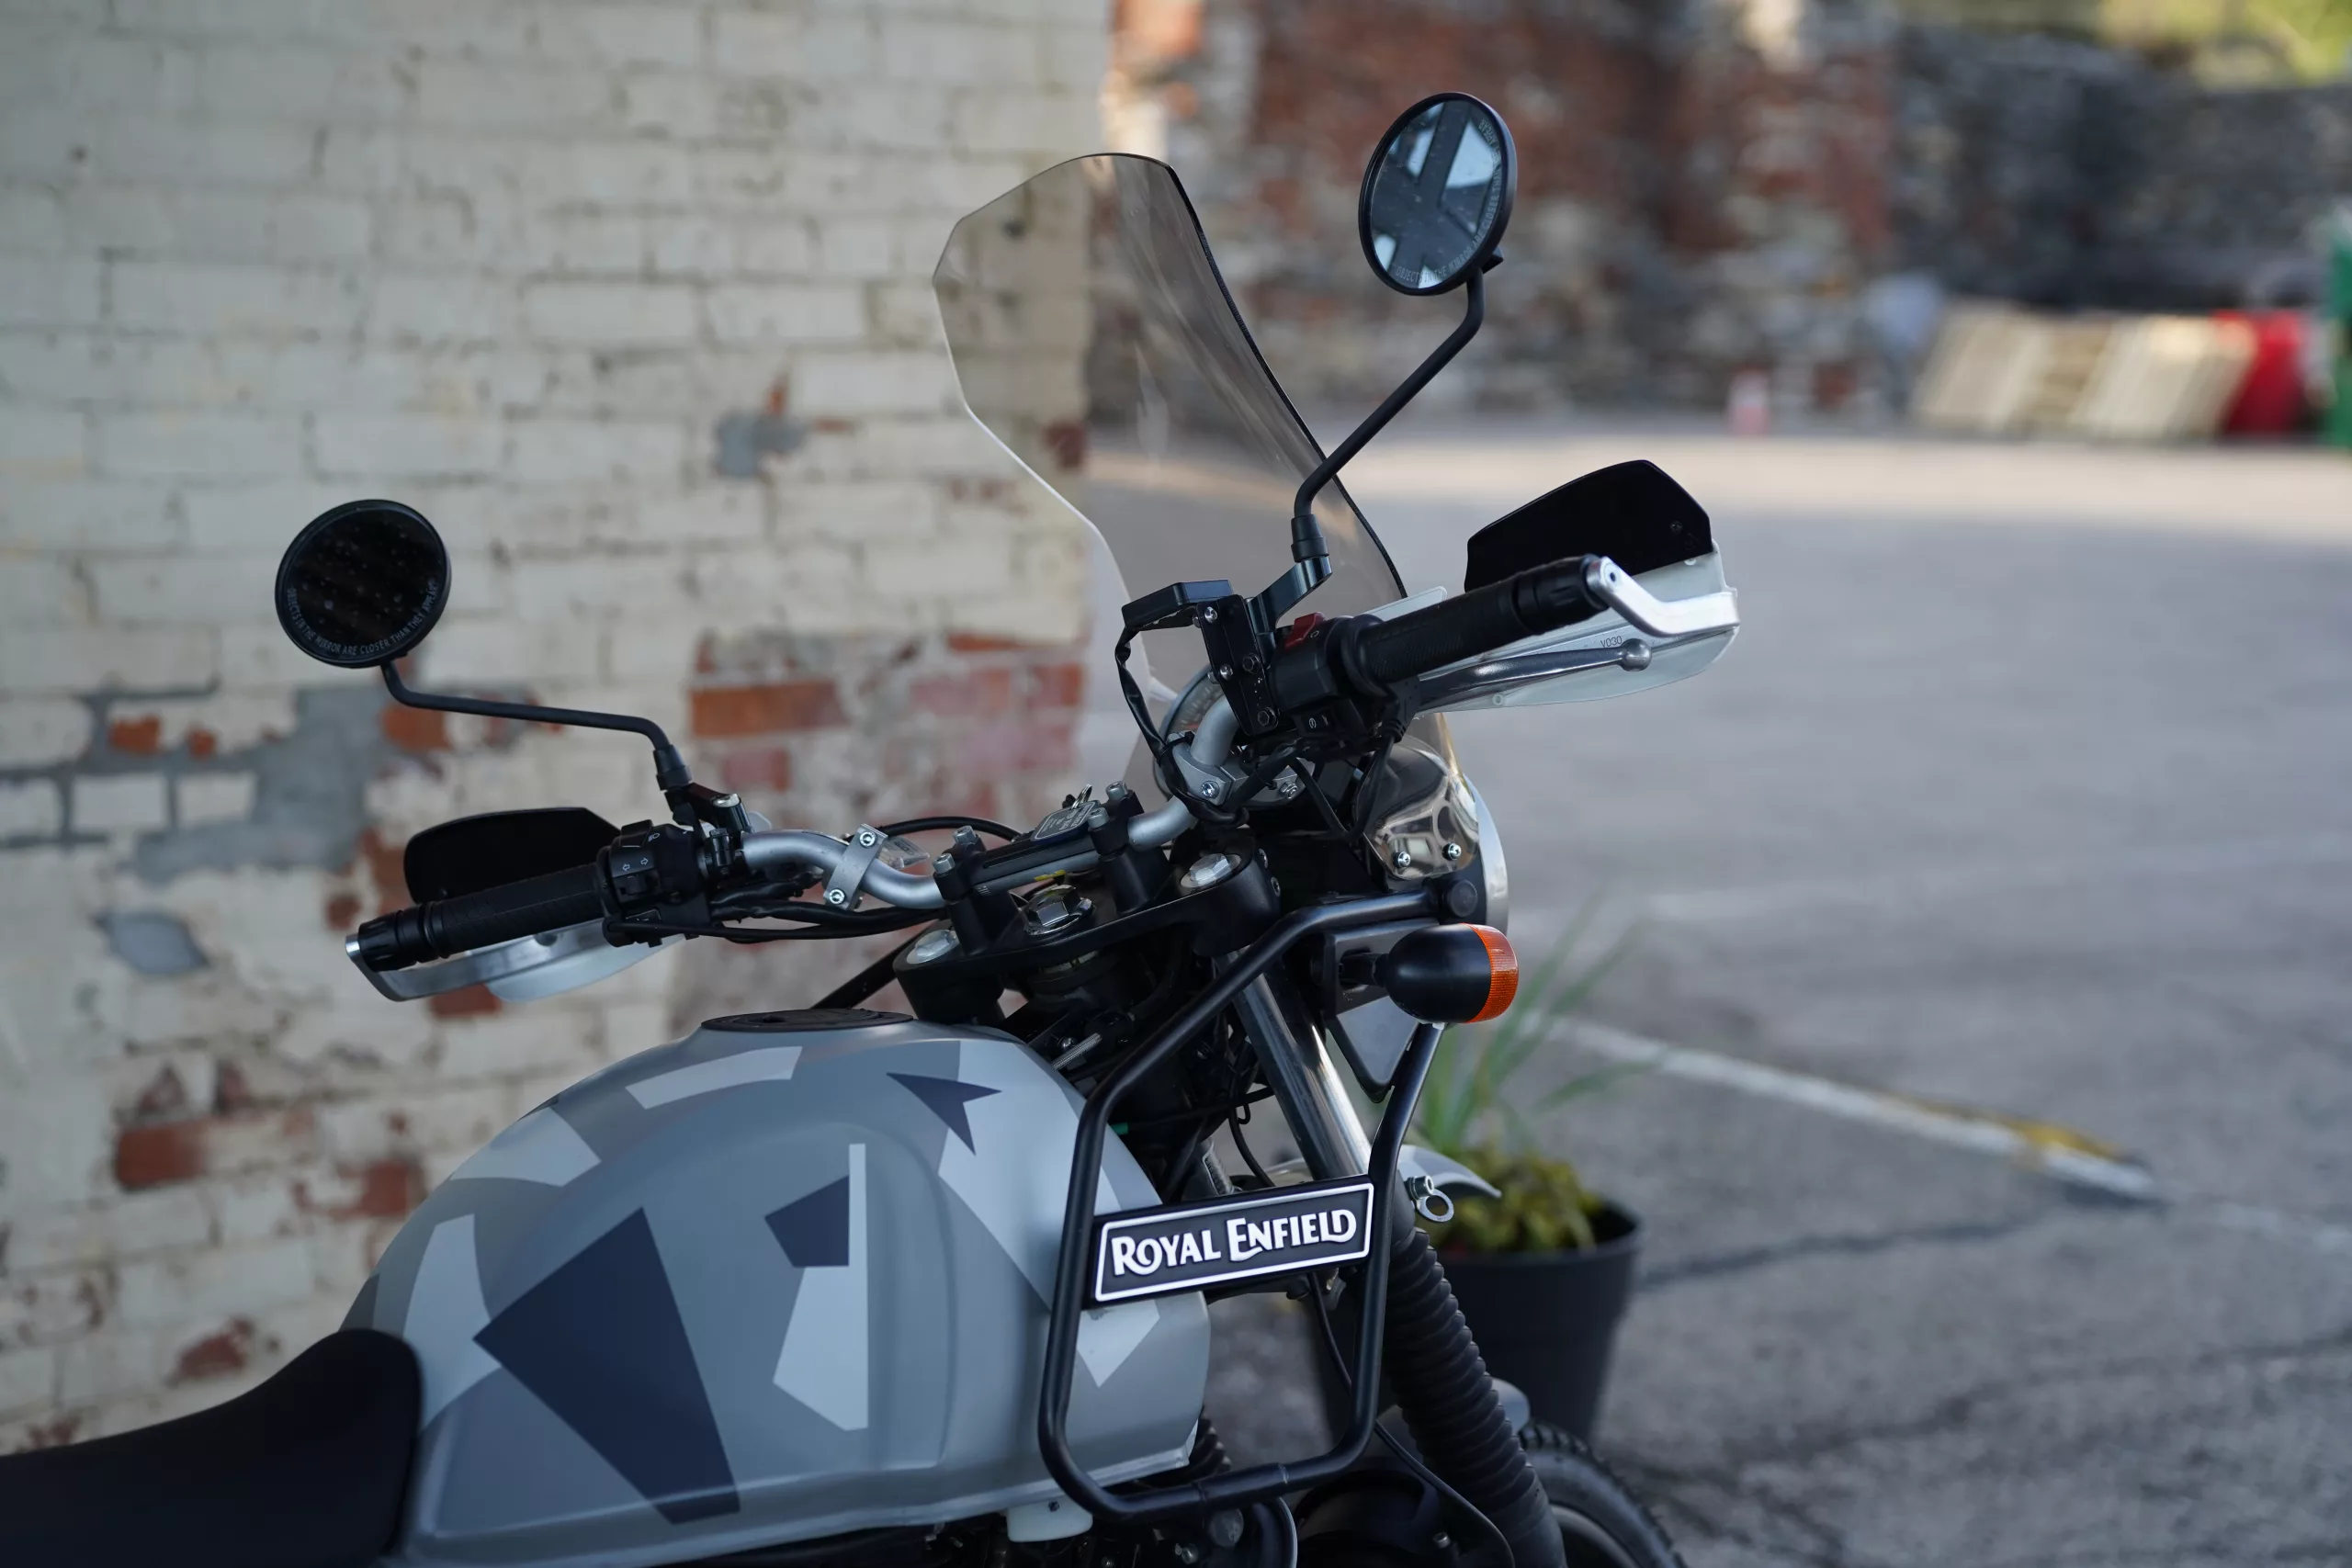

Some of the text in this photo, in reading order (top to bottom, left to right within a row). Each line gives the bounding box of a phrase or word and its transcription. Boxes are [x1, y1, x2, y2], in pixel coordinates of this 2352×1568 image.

[1396, 265, 1423, 283] OBJECTS
[342, 645, 358, 656] ARE
[359, 638, 391, 655] CLOSER
[390, 626, 411, 643] THAN
[408, 611, 426, 629] THEY
[1600, 636, 1622, 648] V030
[1111, 1209, 1357, 1277] ROYAL ENFIELD
